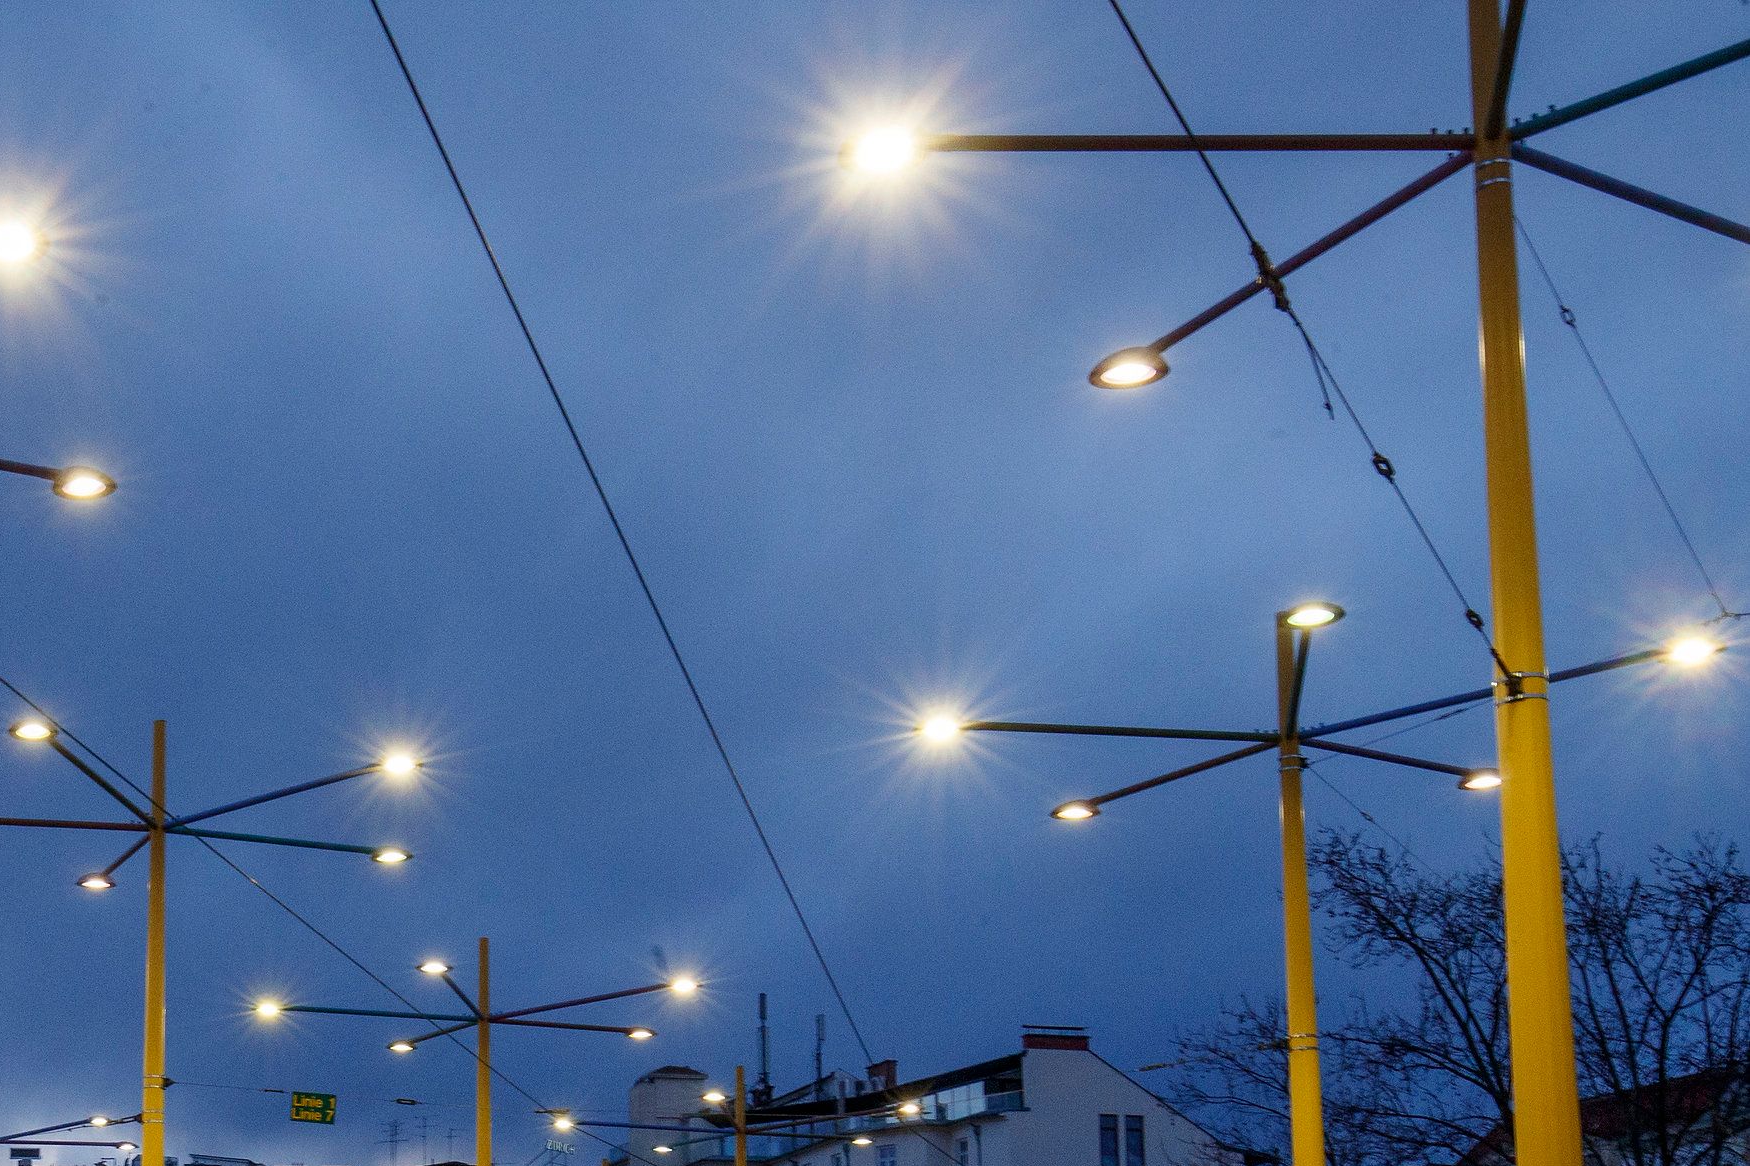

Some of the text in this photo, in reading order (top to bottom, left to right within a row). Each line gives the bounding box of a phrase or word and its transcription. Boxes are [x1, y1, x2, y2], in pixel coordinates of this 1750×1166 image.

[292, 1094, 336, 1109] Linie 1
[290, 1107, 335, 1122] Linie 7
